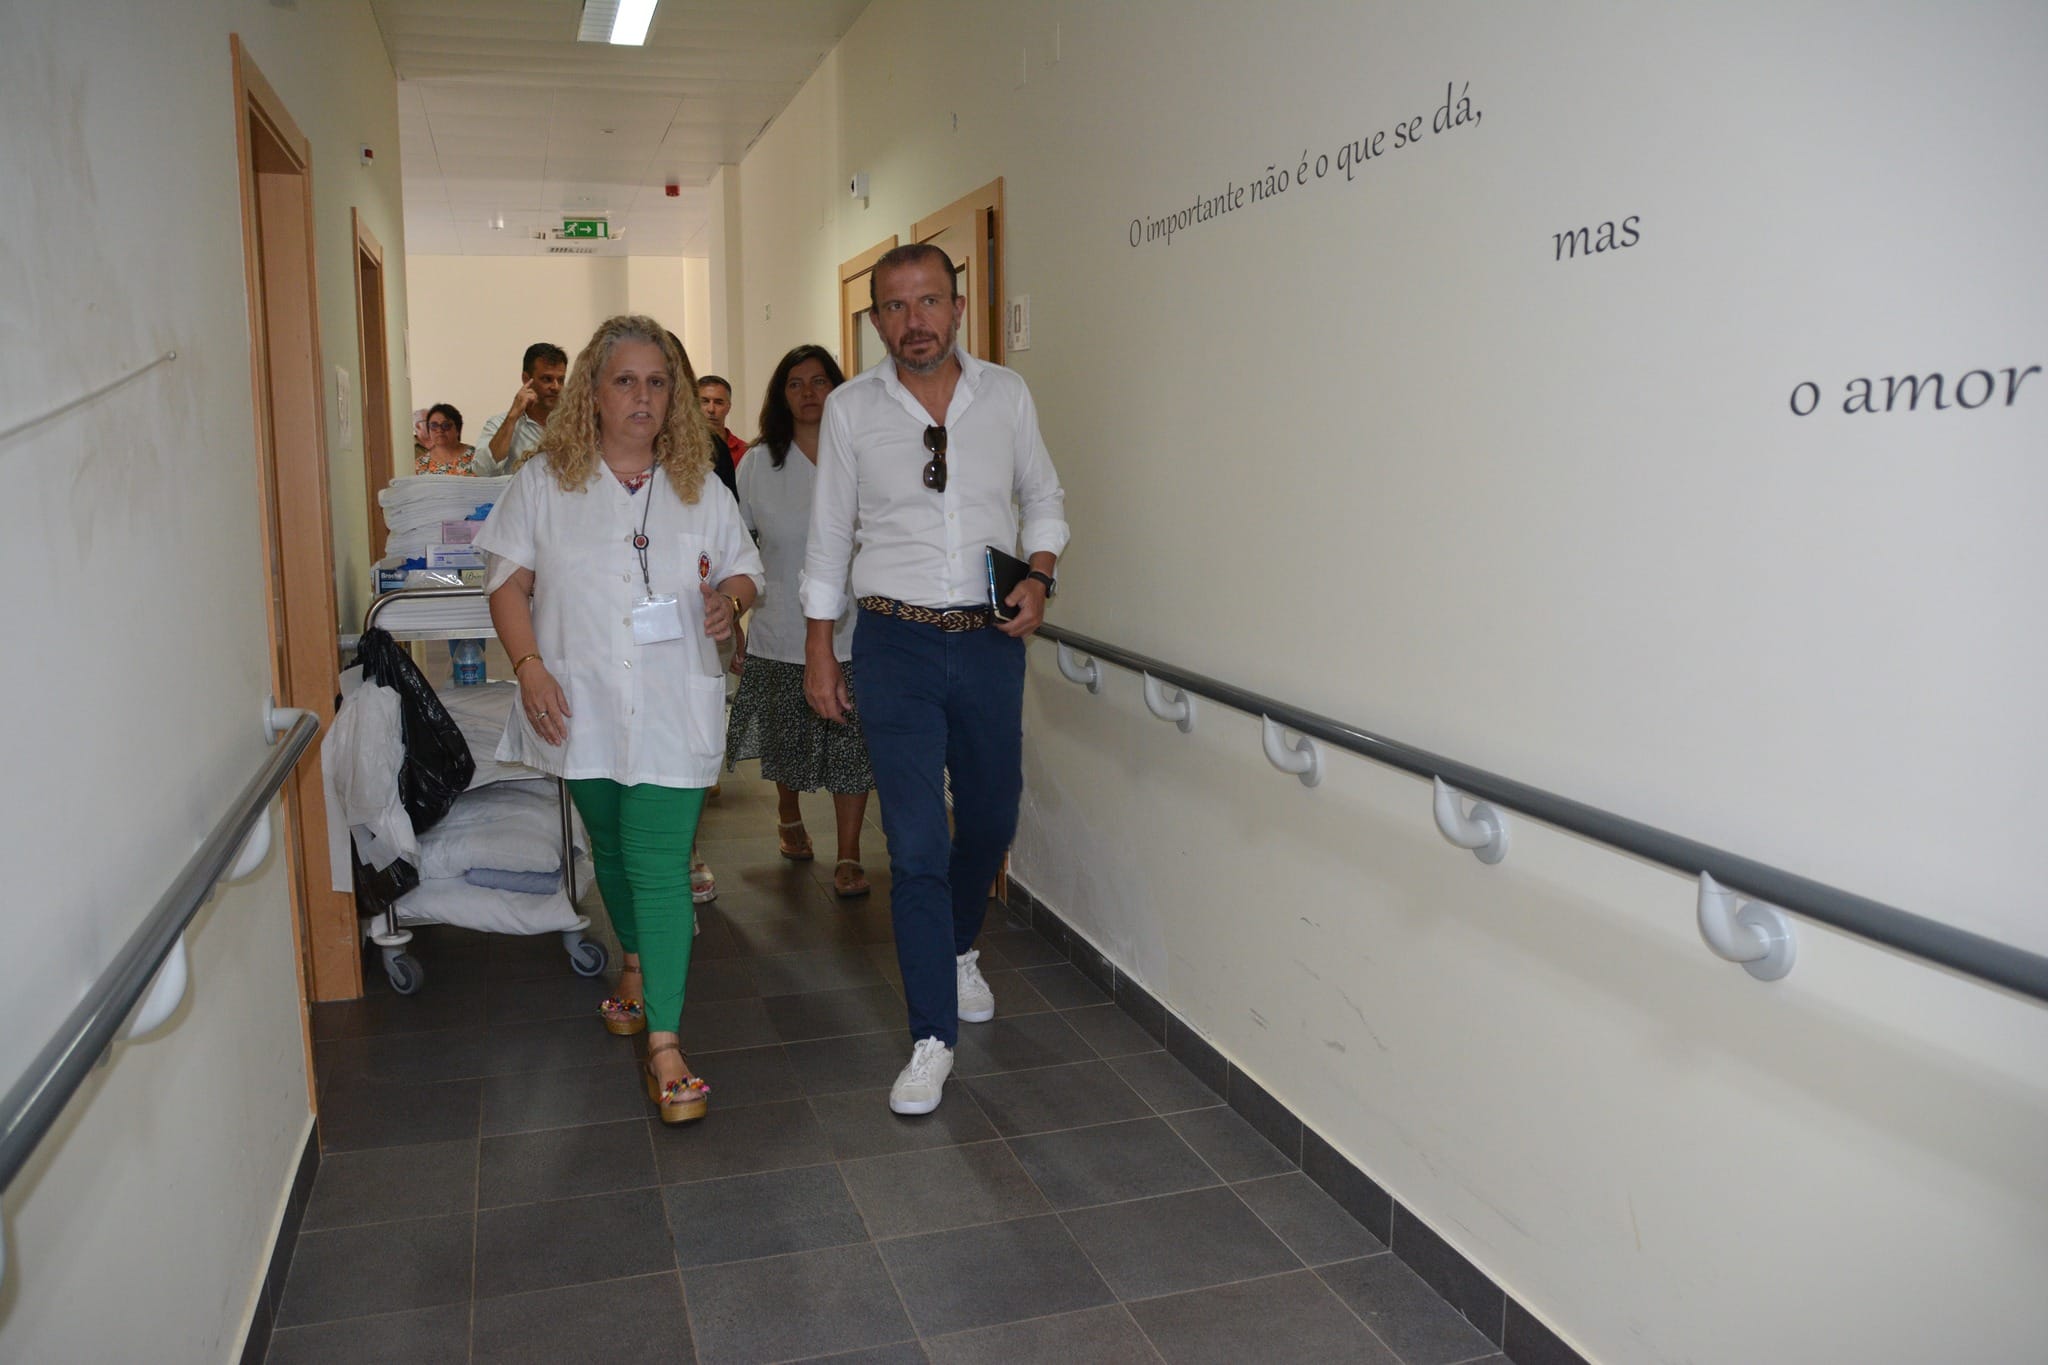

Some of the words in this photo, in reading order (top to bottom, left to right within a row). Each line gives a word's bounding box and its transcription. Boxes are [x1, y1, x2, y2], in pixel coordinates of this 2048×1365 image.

[1129, 219, 1142, 248] O
[1146, 181, 1245, 246] importante
[1249, 165, 1290, 203] não
[1296, 149, 1309, 186] é
[1315, 154, 1329, 179] o
[1337, 130, 1386, 182] que
[1393, 115, 1424, 149] se
[1432, 80, 1483, 135] dá,
[1552, 214, 1642, 262] mas
[1789, 380, 1821, 417] o
[1842, 364, 2044, 415] amor
